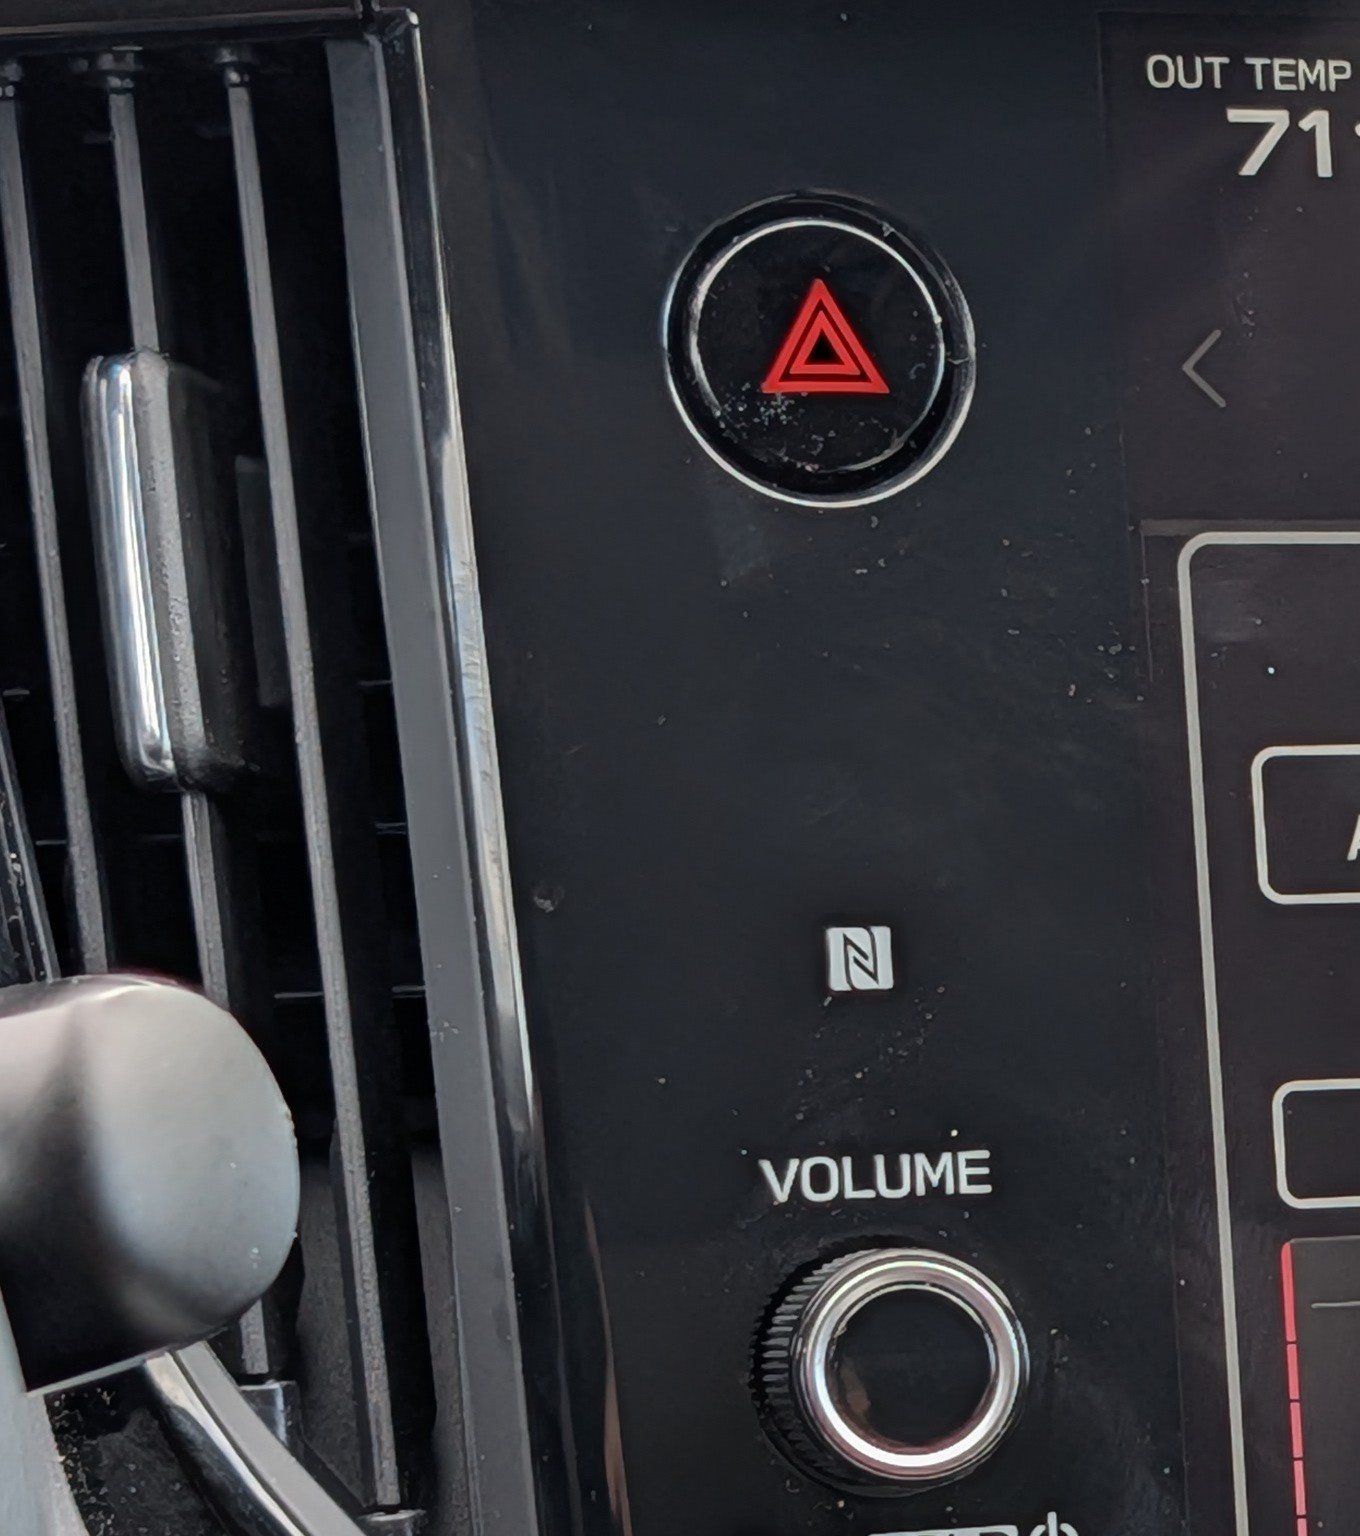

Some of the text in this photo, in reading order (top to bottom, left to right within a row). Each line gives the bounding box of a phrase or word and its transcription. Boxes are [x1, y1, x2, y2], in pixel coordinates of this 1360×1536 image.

[1146, 54, 1352, 92] OUT TEMP
[1226, 108, 1333, 178] 71
[758, 1149, 993, 1203] VOLUME
